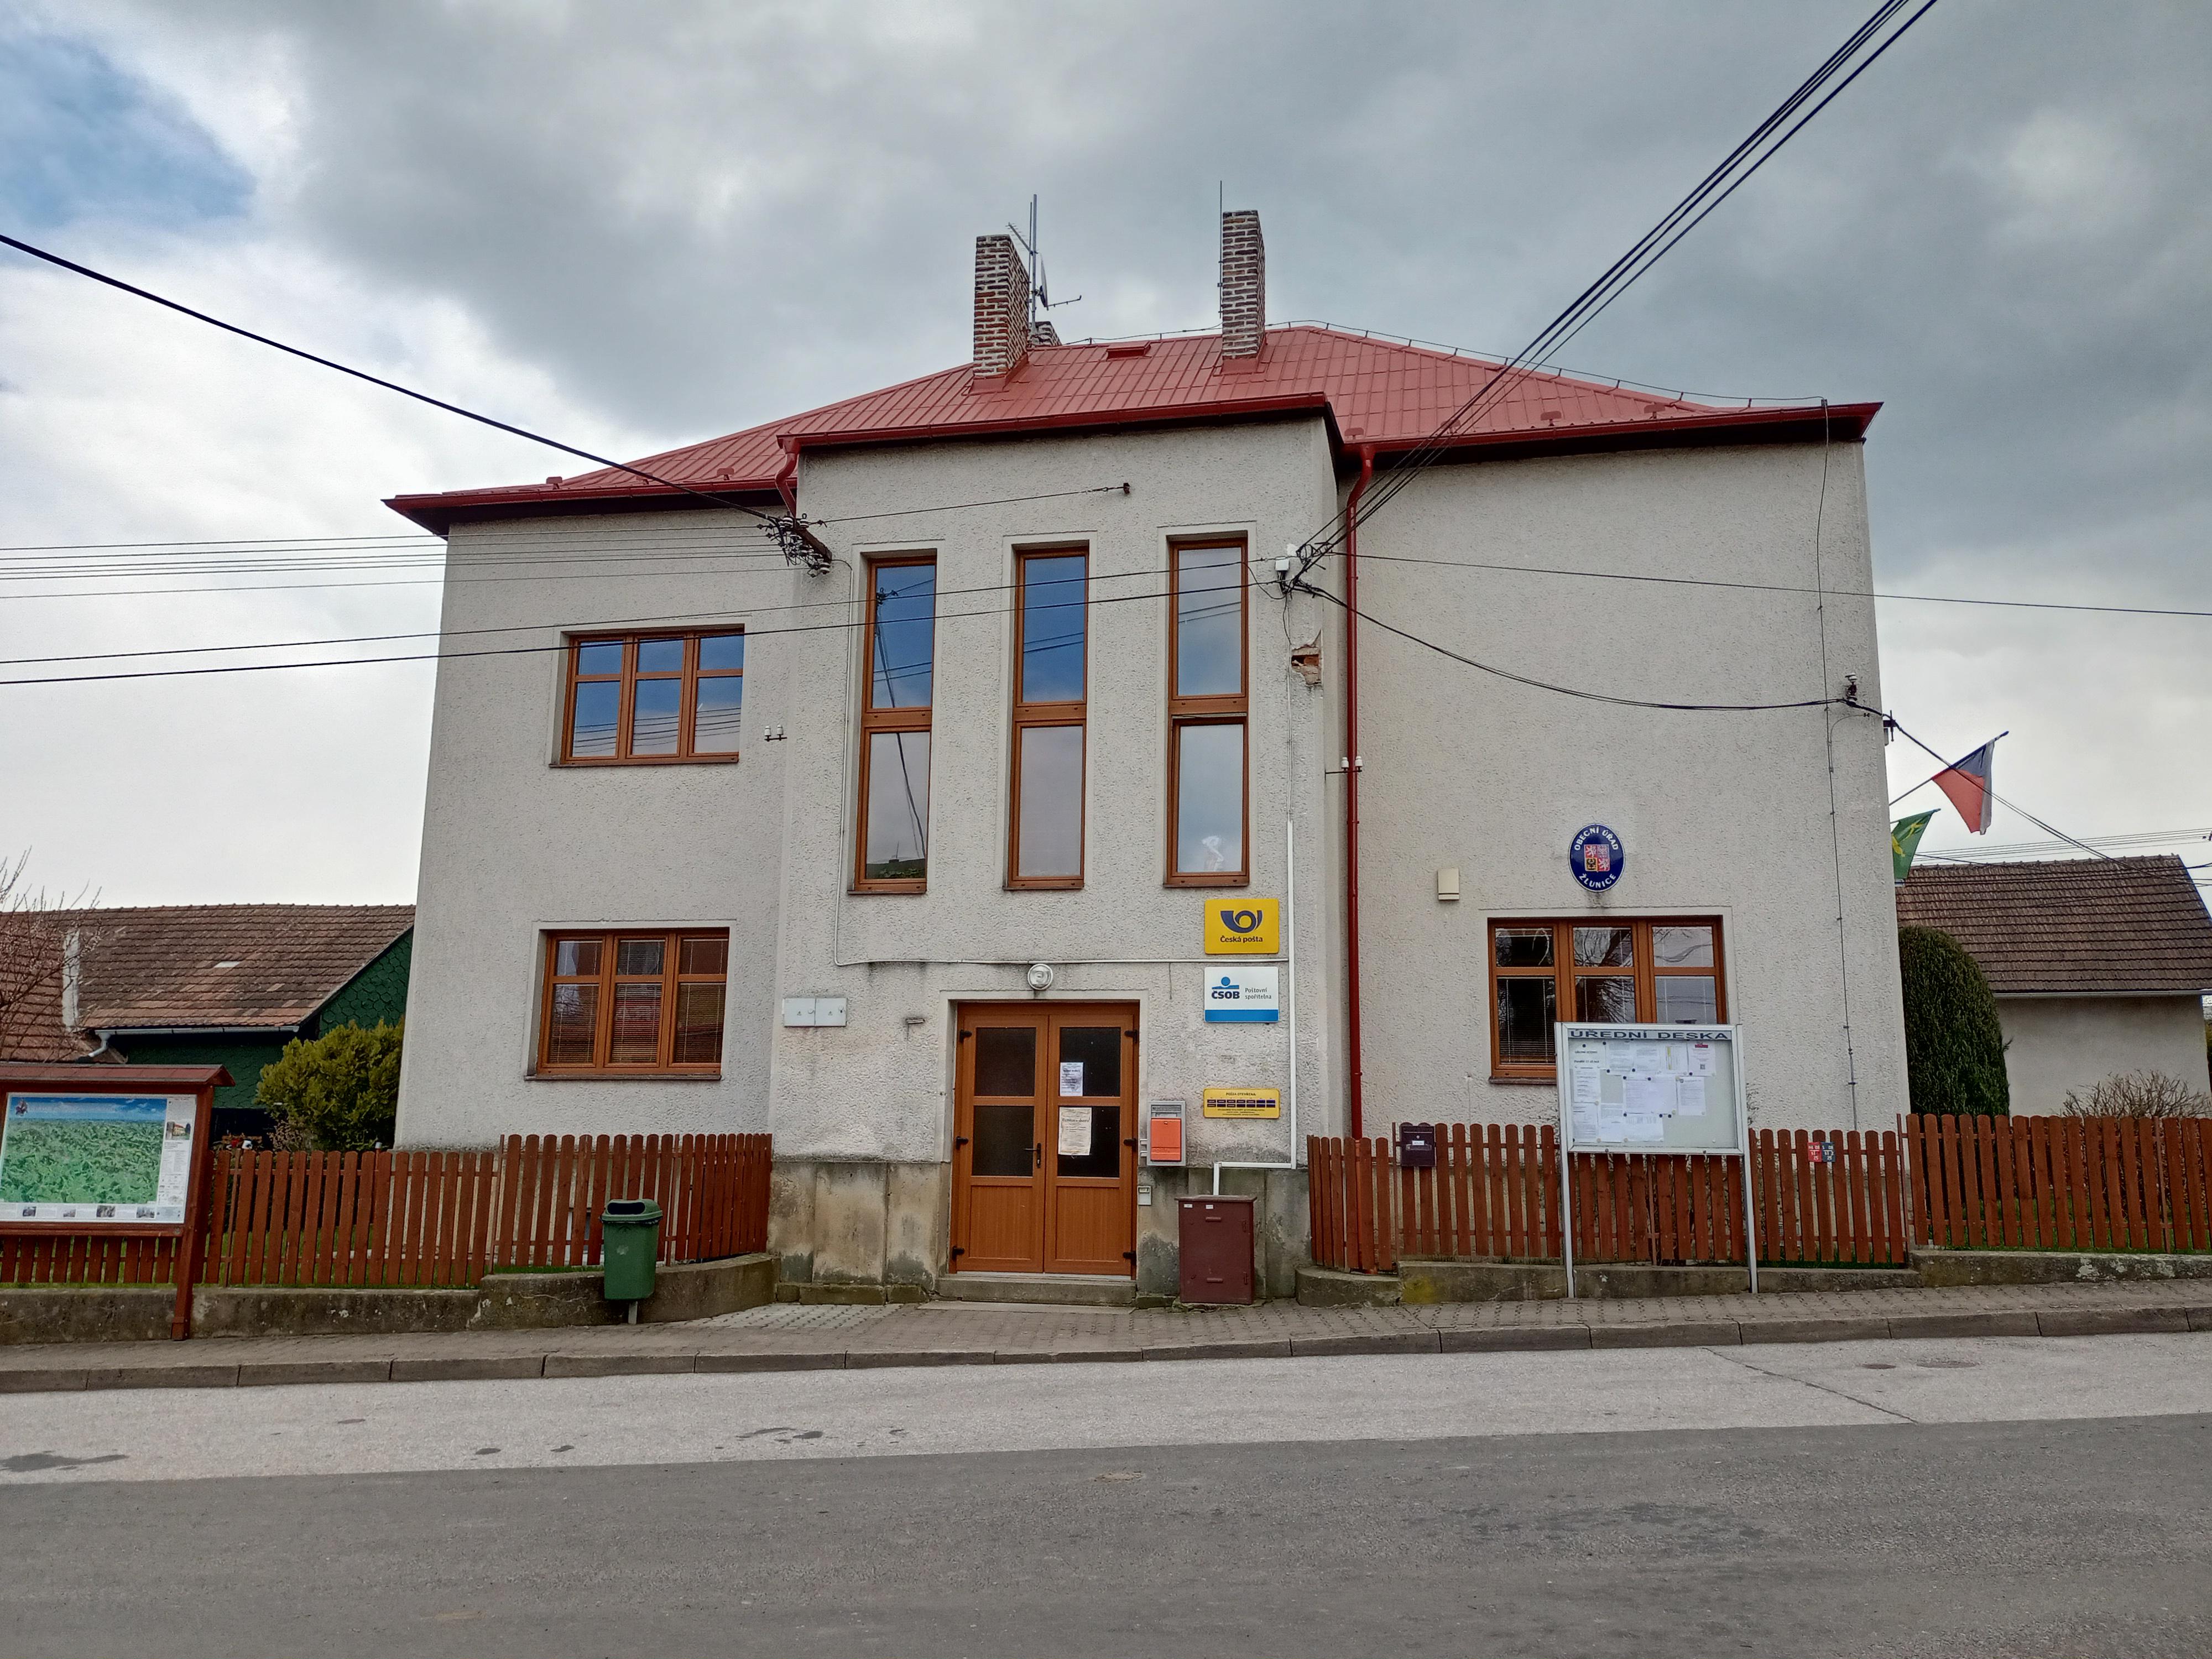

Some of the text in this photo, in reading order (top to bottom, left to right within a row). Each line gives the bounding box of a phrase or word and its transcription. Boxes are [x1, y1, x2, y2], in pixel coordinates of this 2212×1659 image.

[1574, 827, 1619, 851] OBECNÍ ÚŘAD
[1579, 874, 1616, 888] ŽLUNICE
[1211, 990, 1240, 999] ČSOB
[1571, 1028, 1647, 1038] ÚŘEDNÍ
